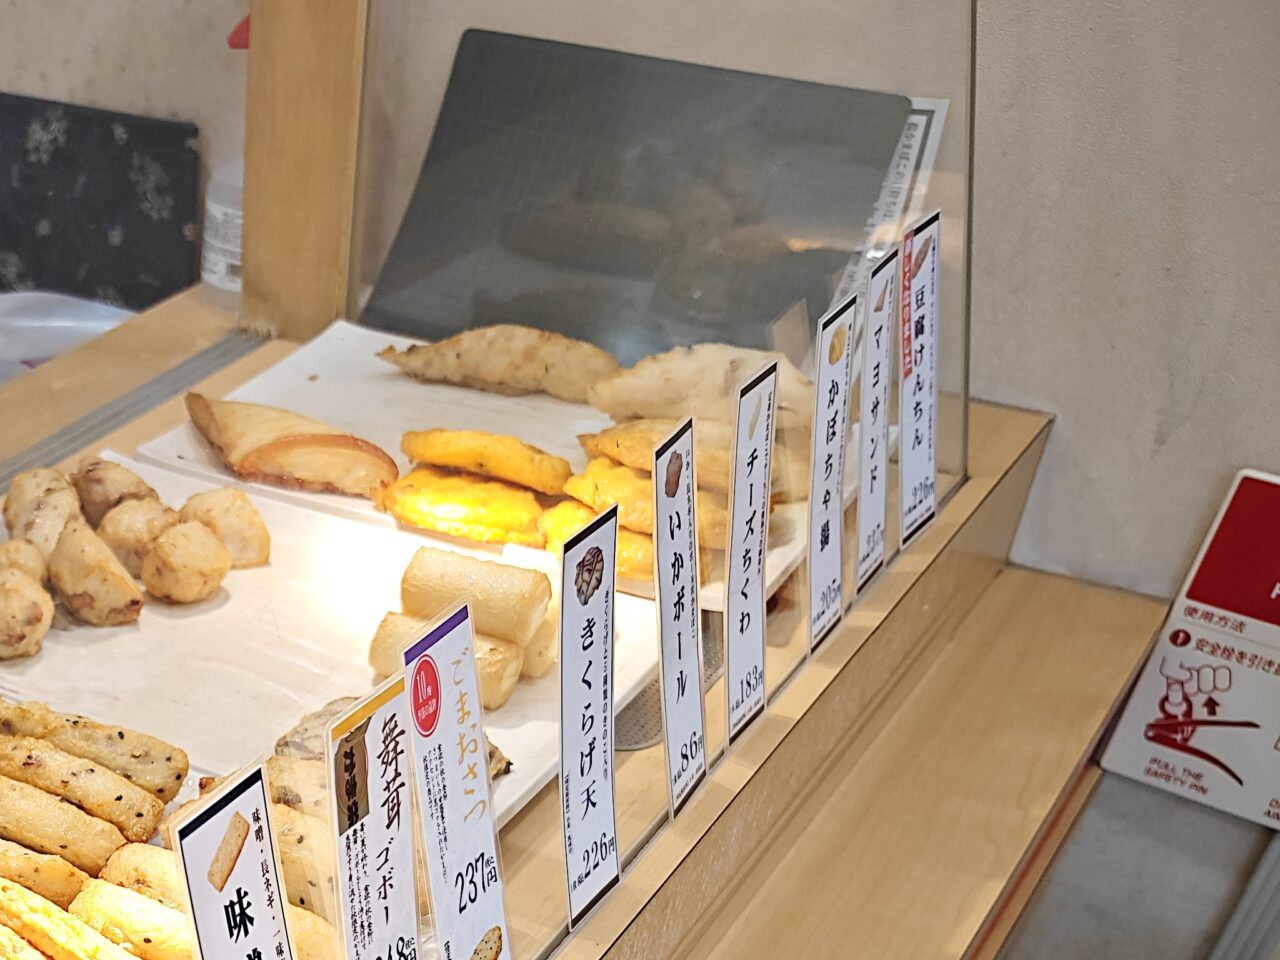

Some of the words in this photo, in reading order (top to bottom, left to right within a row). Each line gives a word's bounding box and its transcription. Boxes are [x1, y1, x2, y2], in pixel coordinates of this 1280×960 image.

[868, 323, 884, 495] マヨサンド
[912, 286, 927, 452] 豆腐けんちん
[668, 511, 687, 706] いかボール
[738, 447, 760, 637] チーズちくわ
[1183, 605, 1246, 634] 使用方法
[450, 646, 487, 823] ごまおさつ
[579, 617, 597, 820] きくらげ天
[1144, 767, 1186, 785] SAFETY
[1189, 782, 1208, 795] PIN
[1149, 756, 1175, 773] PULL
[1183, 768, 1203, 782] THE
[454, 852, 498, 915] 237円
[582, 832, 614, 879] 226円
